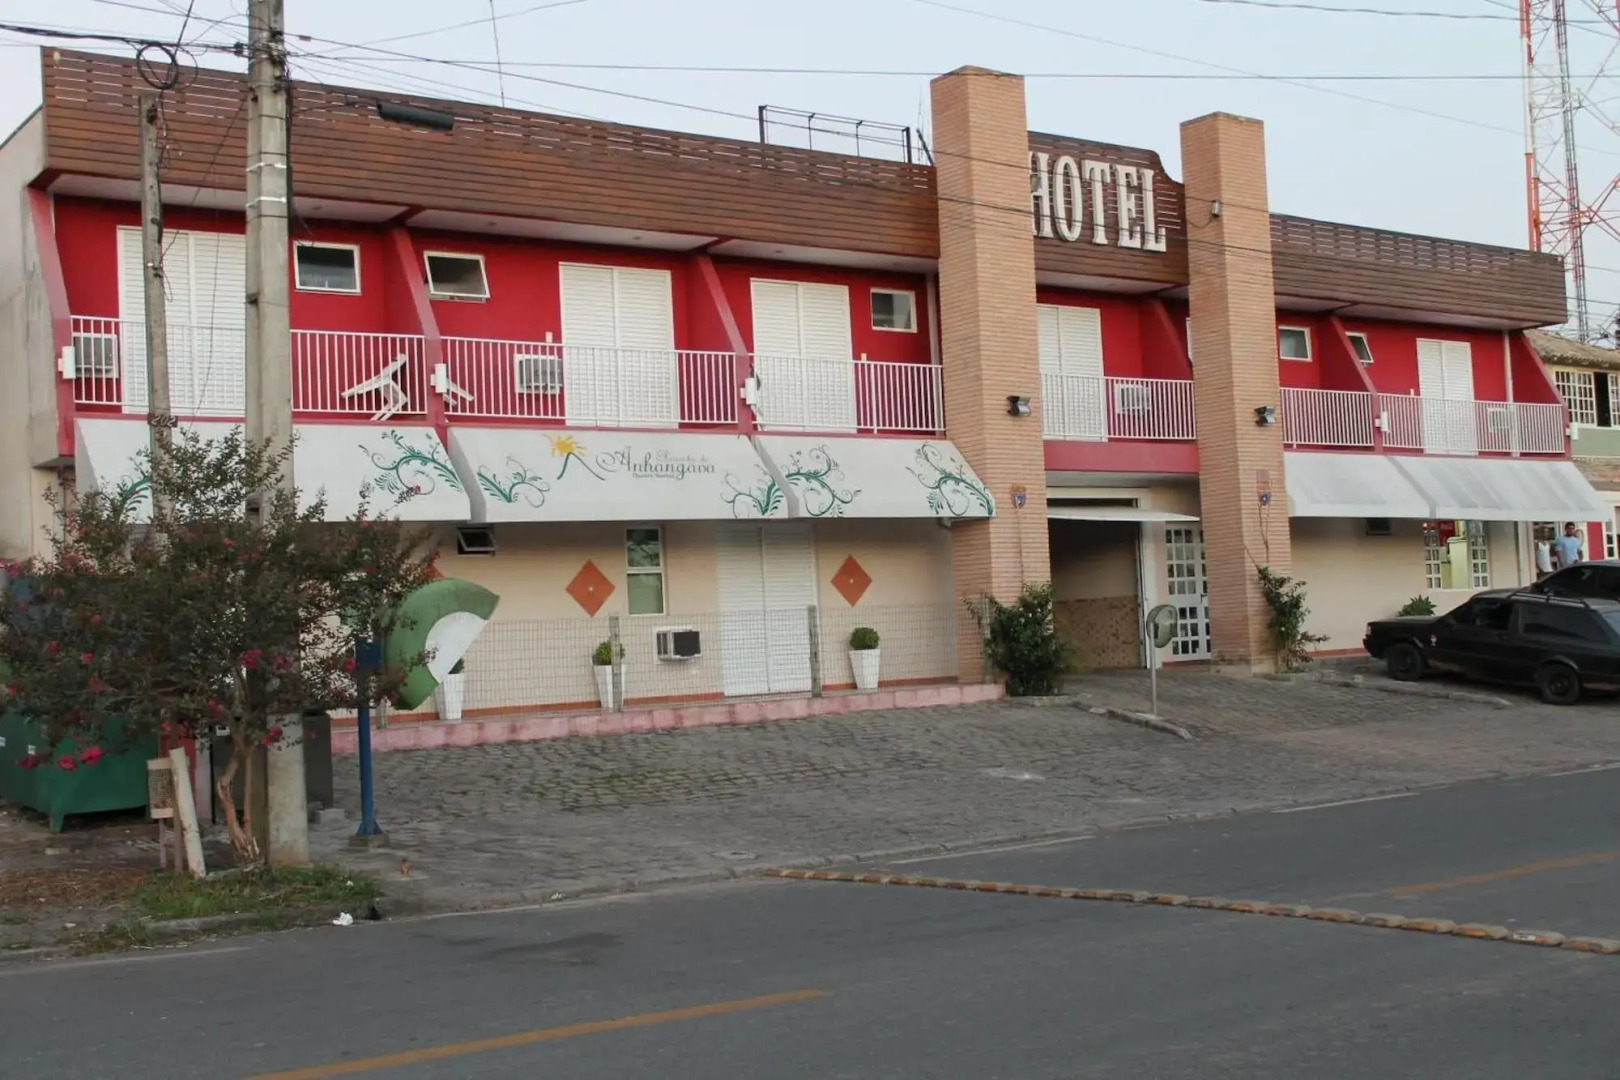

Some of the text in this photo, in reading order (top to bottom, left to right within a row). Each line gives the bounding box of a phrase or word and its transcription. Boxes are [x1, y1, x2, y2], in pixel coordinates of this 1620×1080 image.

[1029, 151, 1167, 252] HOTEL
[151, 413, 176, 427] 202
[596, 445, 715, 480] Anhangava
